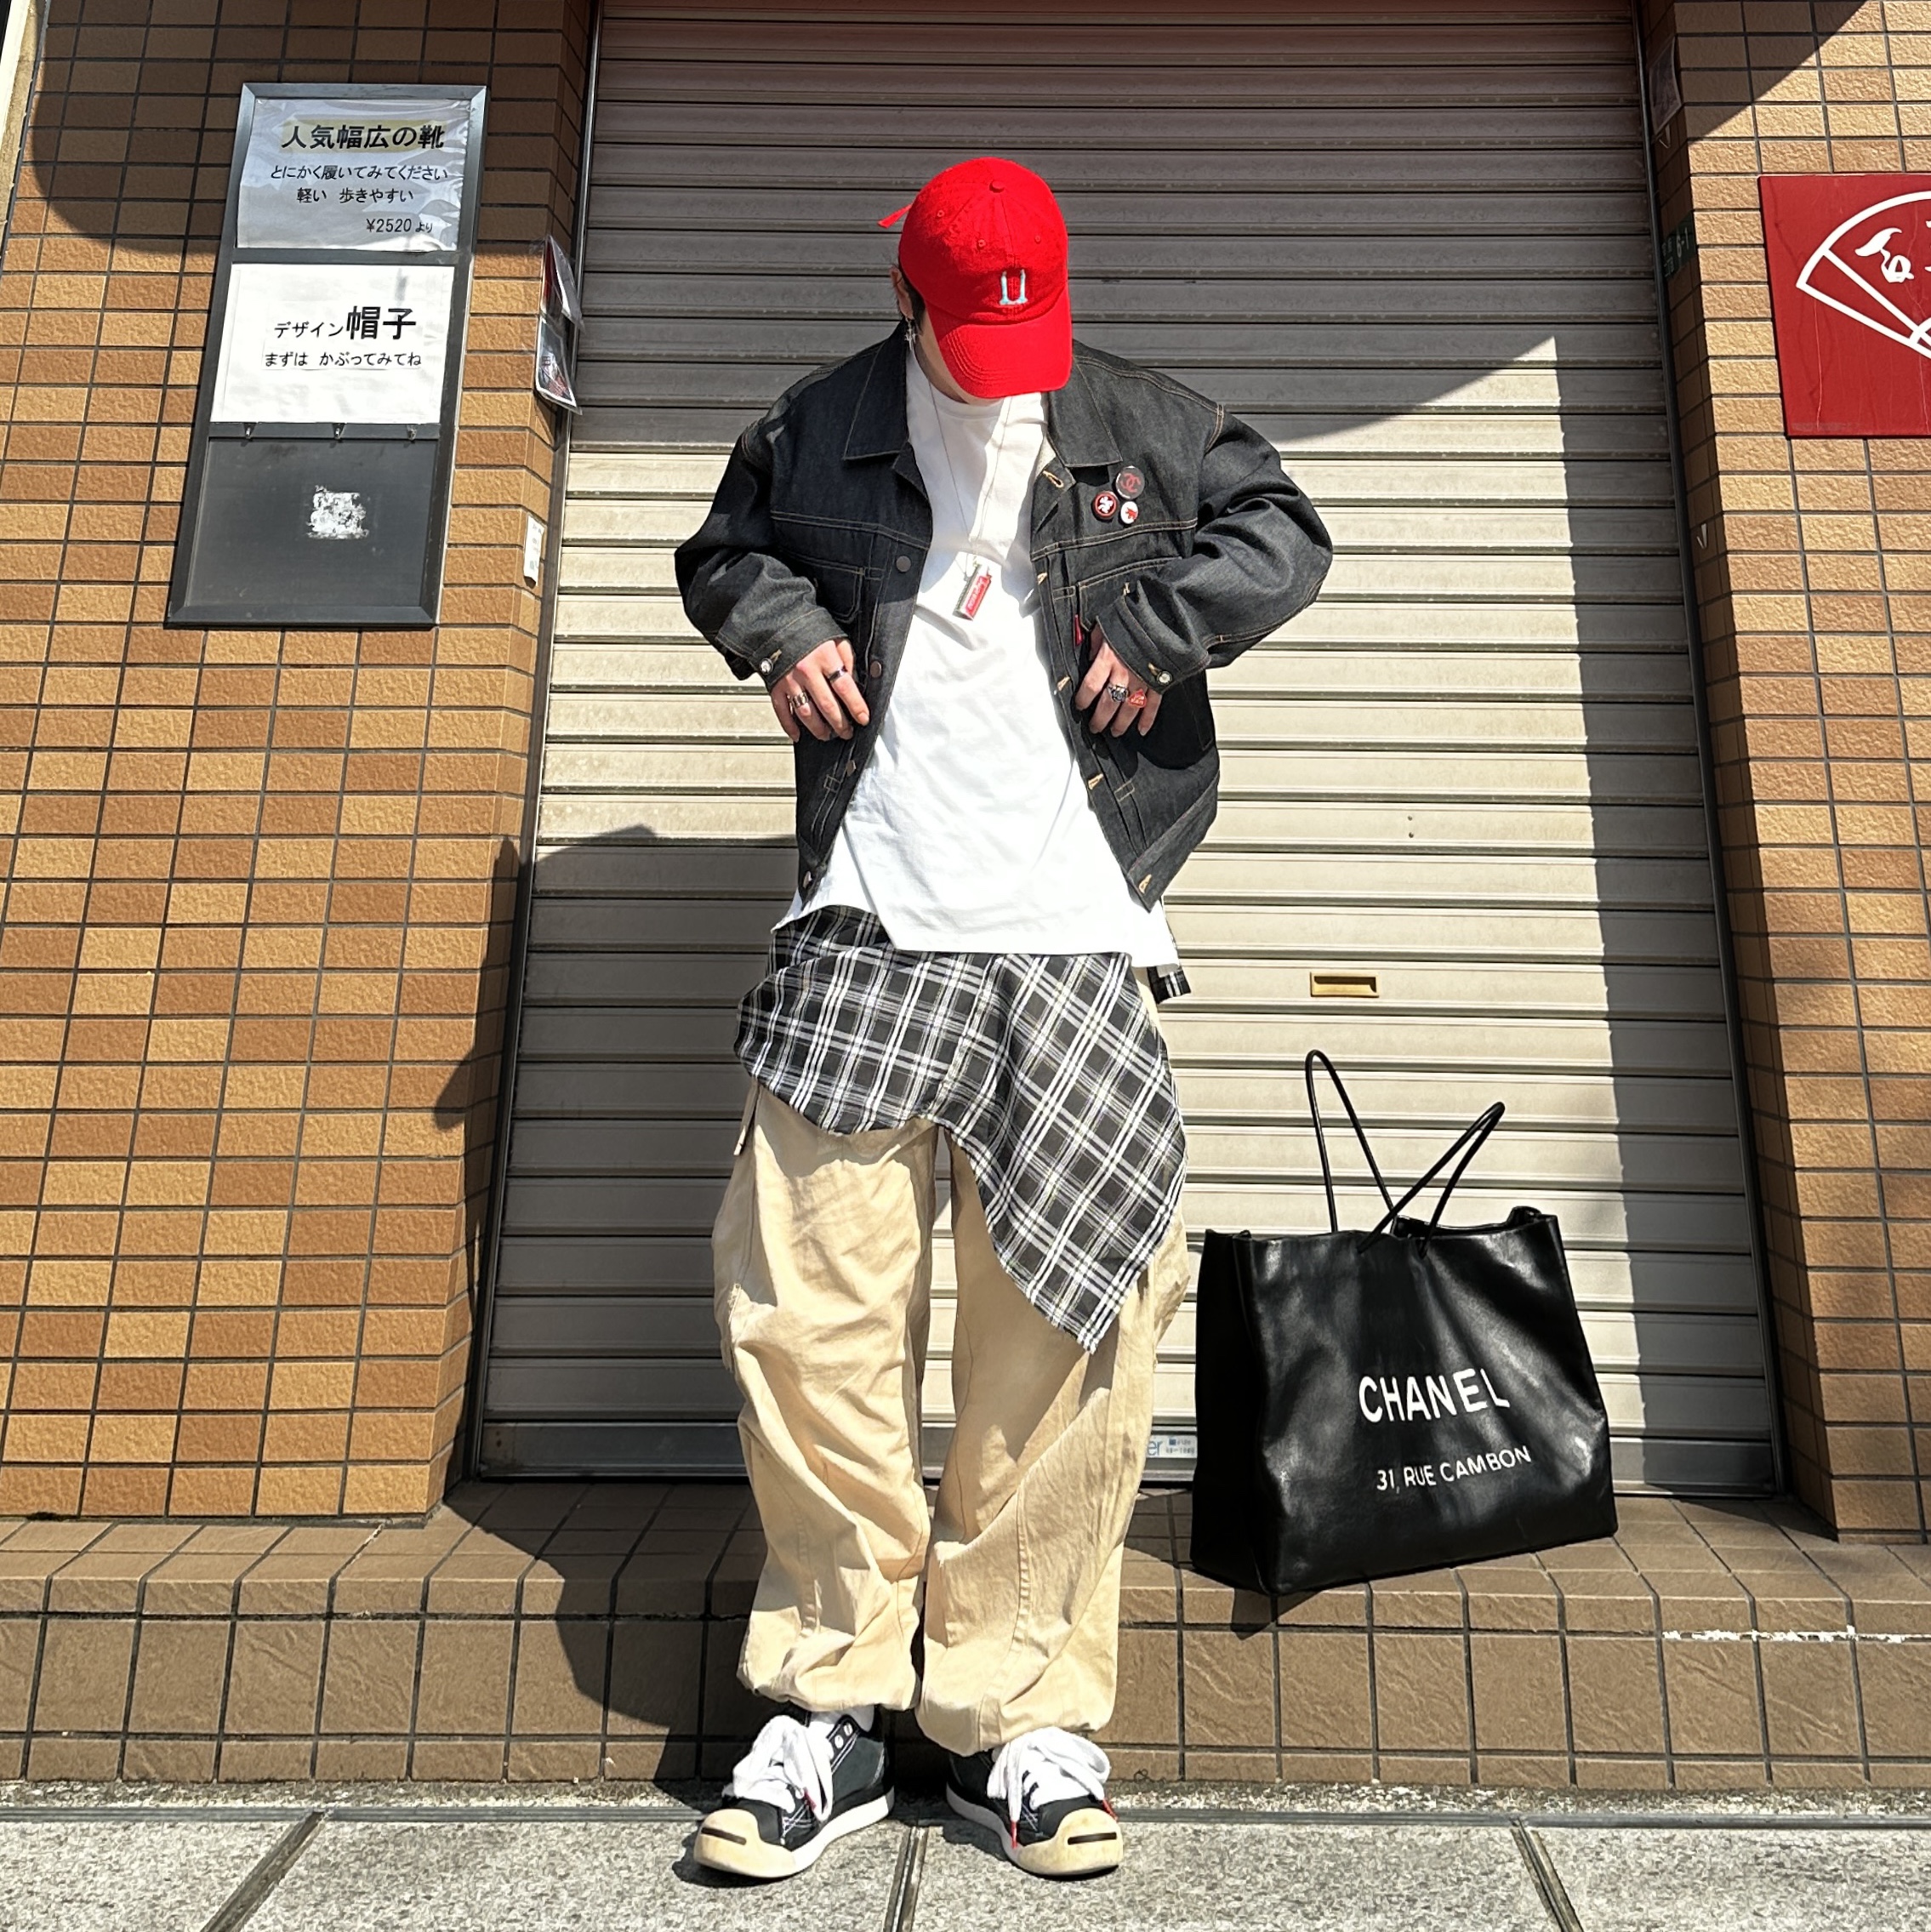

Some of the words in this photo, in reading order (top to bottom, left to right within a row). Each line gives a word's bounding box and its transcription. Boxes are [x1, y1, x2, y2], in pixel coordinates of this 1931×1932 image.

[282, 124, 444, 150] 人気幅広の靴
[271, 165, 447, 180] とにかく履いてみてください
[297, 187, 327, 203] 軽い
[339, 187, 414, 204] 歩きやすい
[415, 221, 433, 233] より
[274, 305, 417, 340] デザイン帽子
[265, 351, 309, 368] まずは
[319, 351, 422, 368] かぶってみてね
[1359, 1368, 1511, 1423] CHANEL
[1376, 1468, 1400, 1494] 31,
[1403, 1464, 1437, 1488] RUE
[1439, 1445, 1532, 1482] CAMBON
